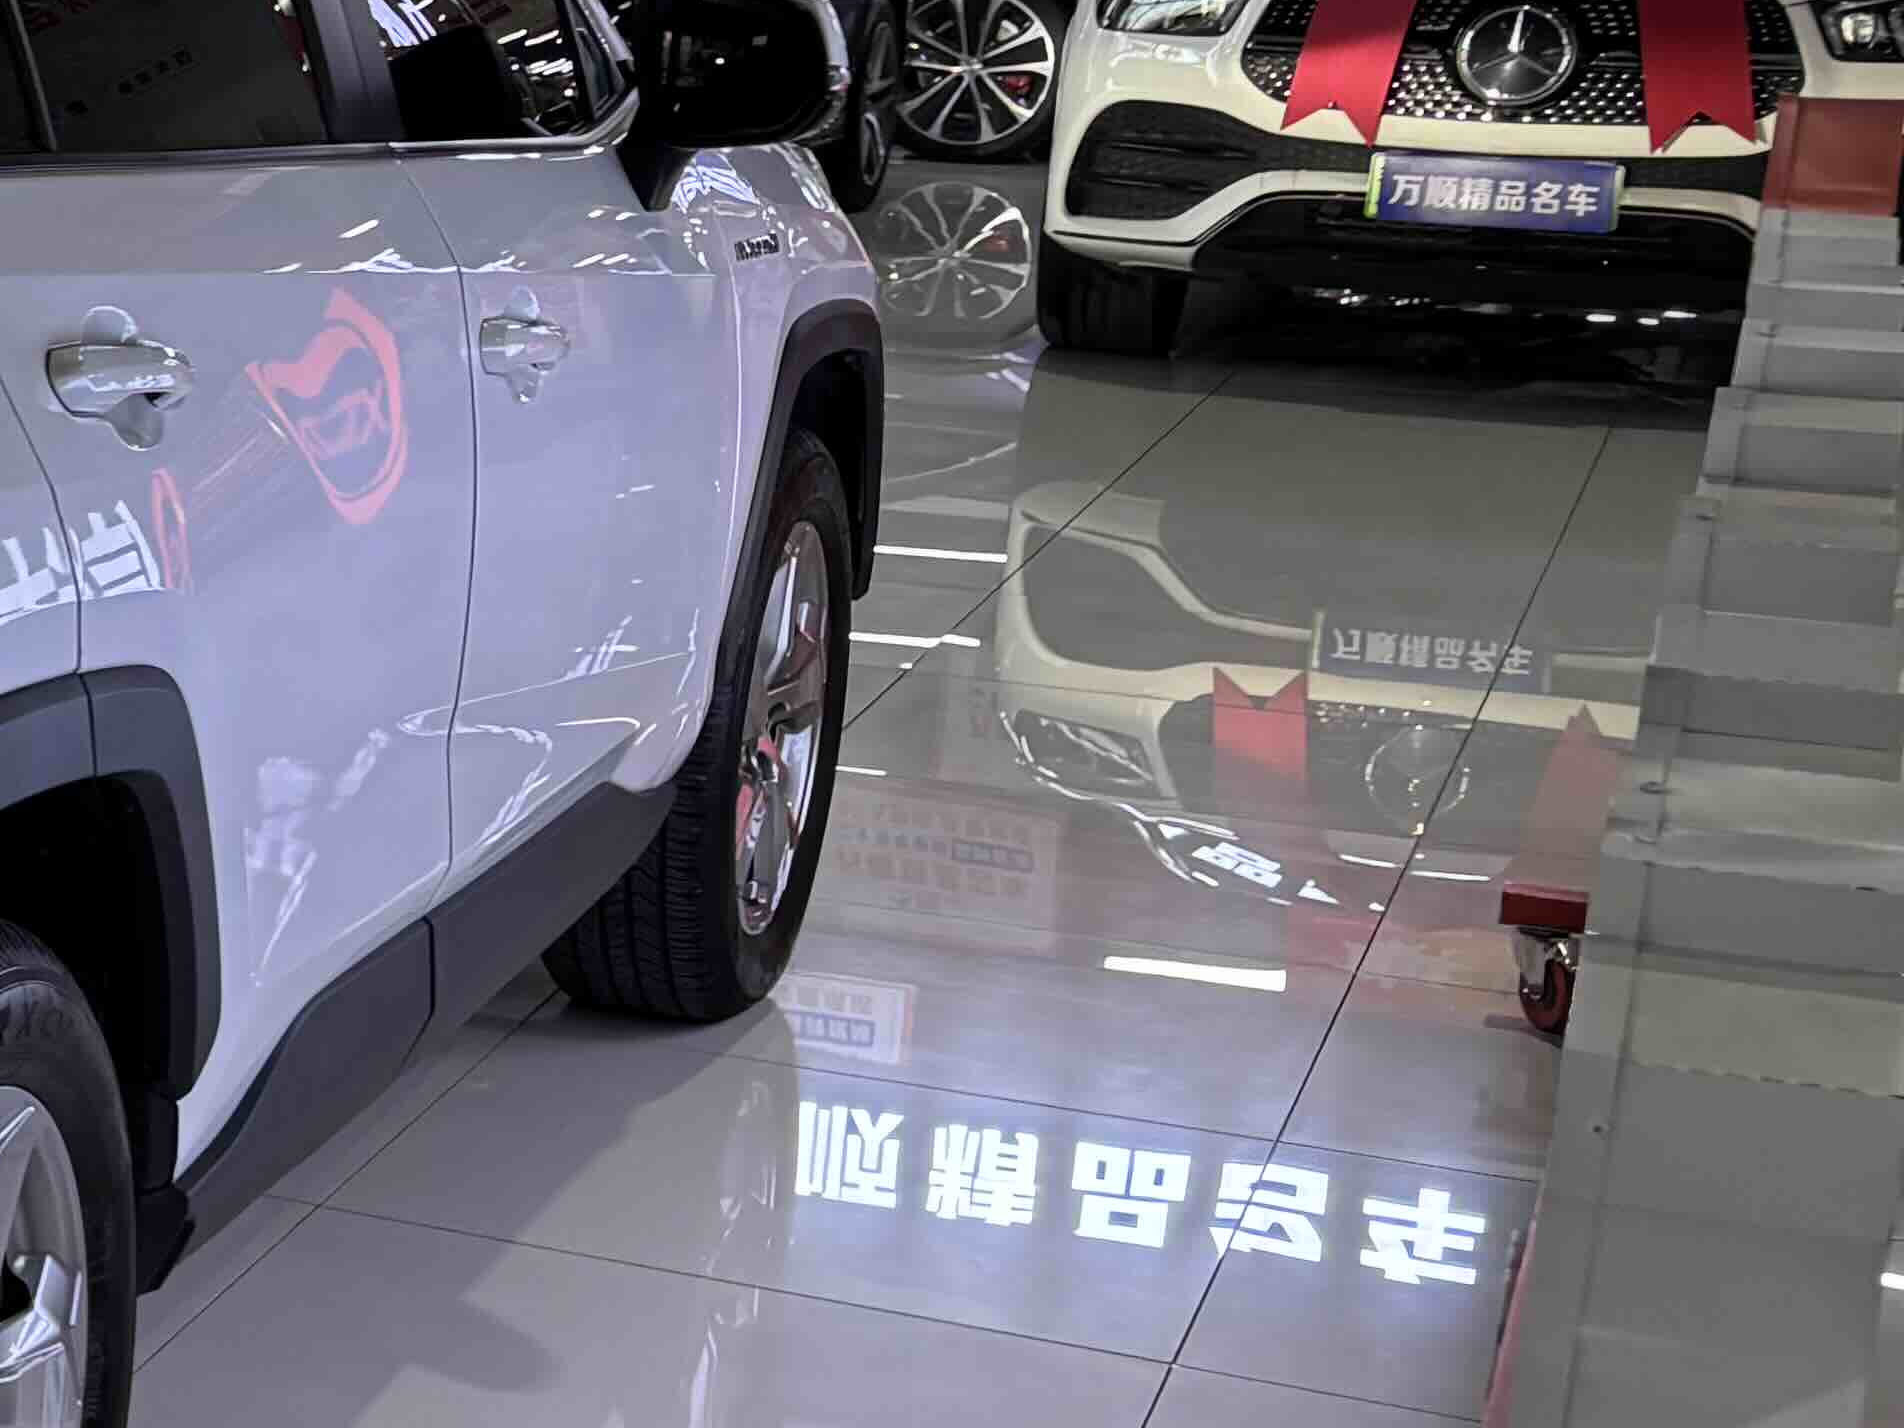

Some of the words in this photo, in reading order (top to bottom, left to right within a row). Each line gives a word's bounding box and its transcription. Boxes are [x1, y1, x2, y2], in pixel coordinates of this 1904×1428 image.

[1389, 173, 1599, 219] 万顺精品名车
